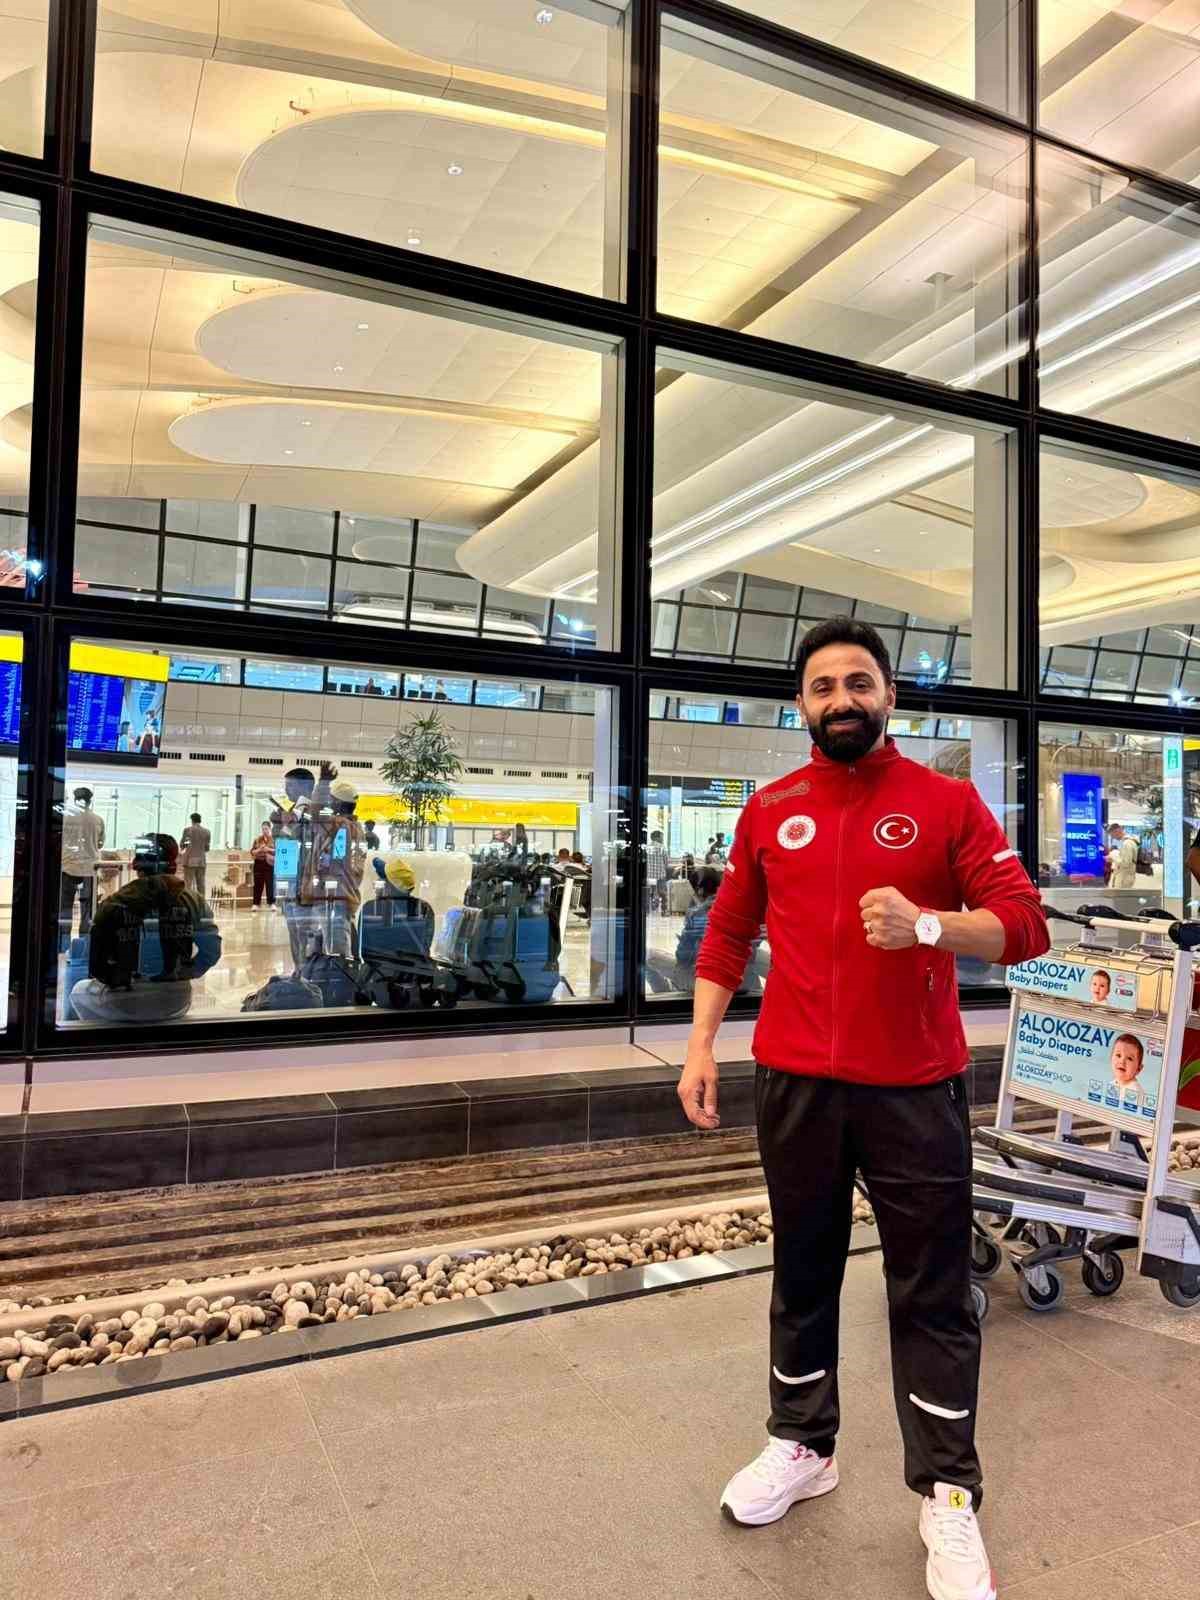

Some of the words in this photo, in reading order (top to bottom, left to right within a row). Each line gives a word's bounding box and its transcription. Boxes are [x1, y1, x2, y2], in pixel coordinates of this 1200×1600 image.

[1009, 971, 1032, 986] Baby
[1033, 976, 1068, 991] Diapers
[1019, 1030, 1046, 1048] Baby
[1048, 1037, 1092, 1058] Diapers
[1020, 1013, 1115, 1048] ALOKOZAY
